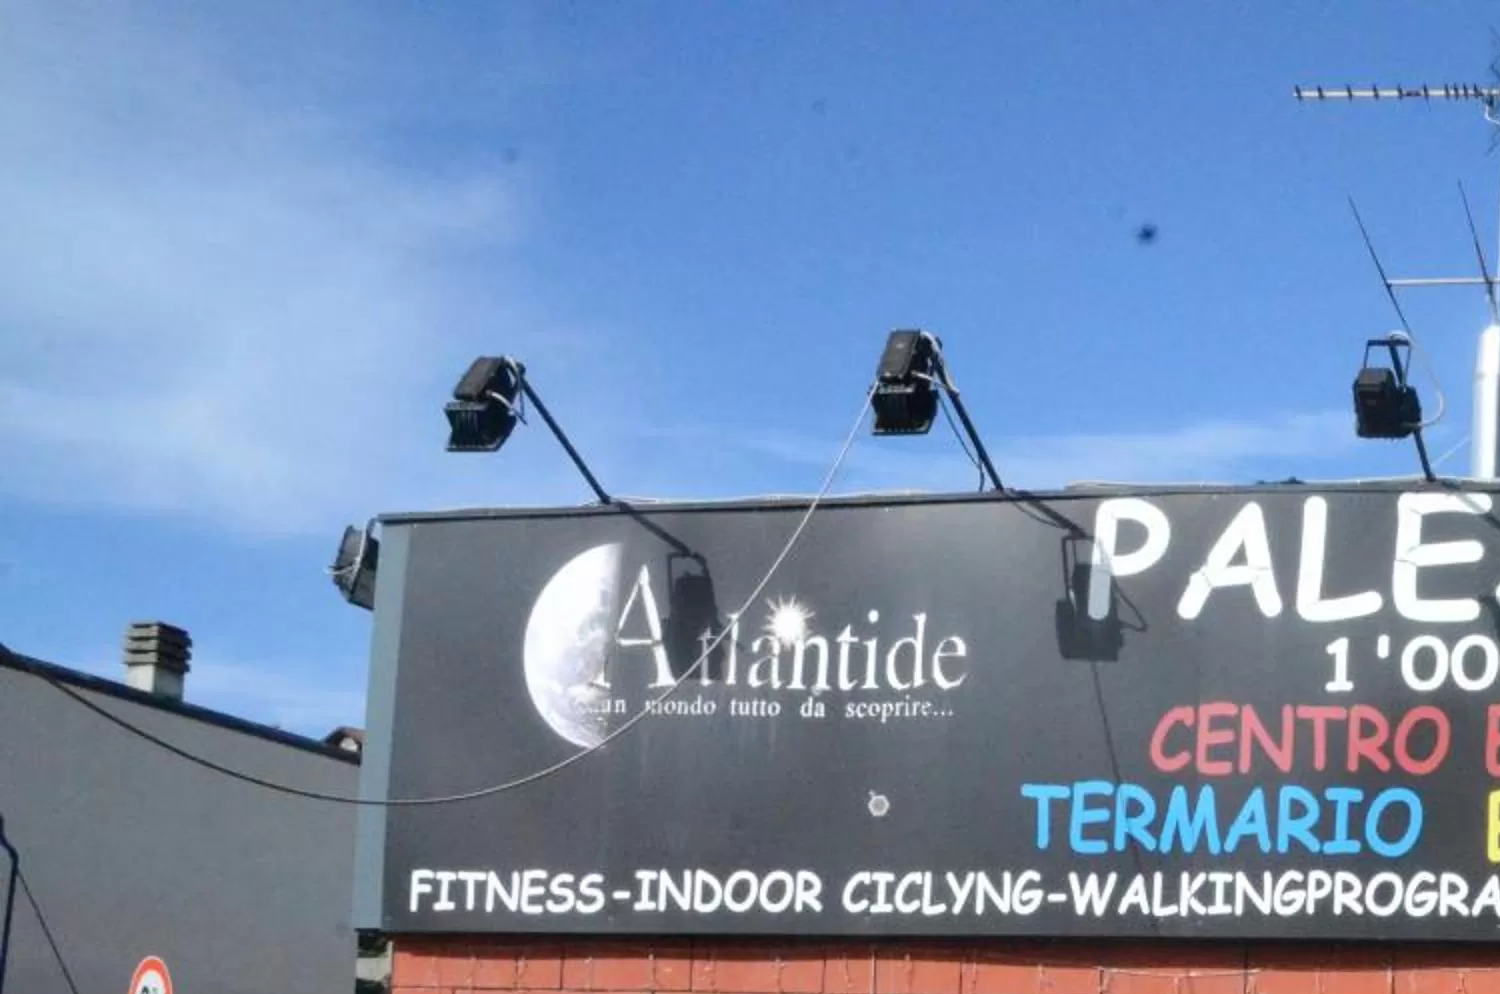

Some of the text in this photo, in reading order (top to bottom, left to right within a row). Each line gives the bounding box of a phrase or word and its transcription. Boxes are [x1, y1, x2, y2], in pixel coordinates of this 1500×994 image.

[590, 563, 969, 692] Atlantide
[729, 696, 782, 718] tutto
[799, 694, 827, 719] da
[1149, 702, 1452, 774] CENTRO
[1021, 780, 1425, 857] TERMARIO
